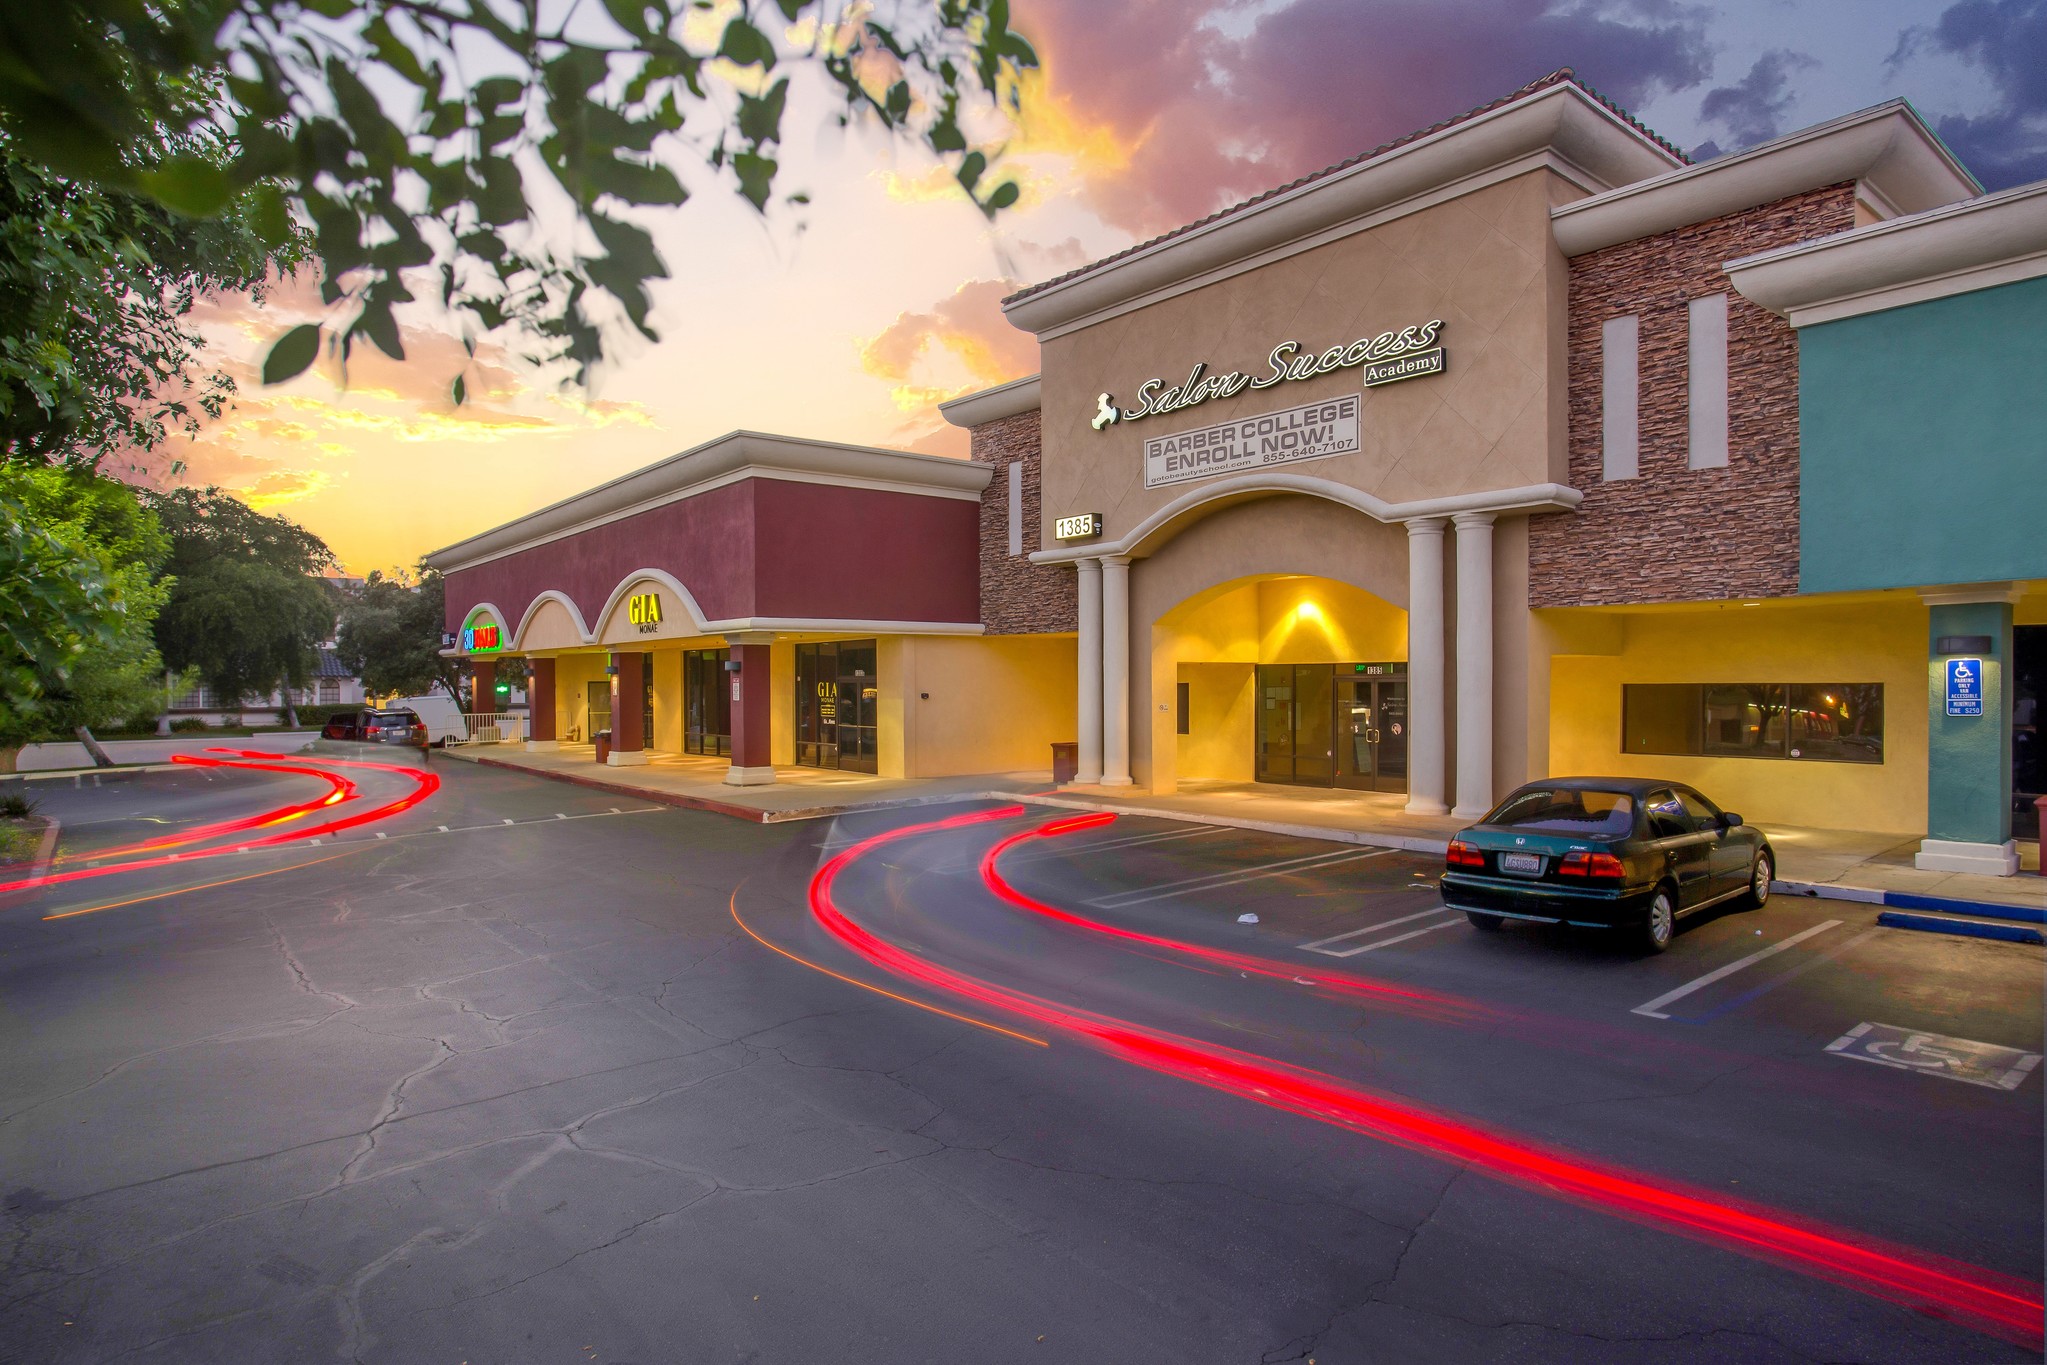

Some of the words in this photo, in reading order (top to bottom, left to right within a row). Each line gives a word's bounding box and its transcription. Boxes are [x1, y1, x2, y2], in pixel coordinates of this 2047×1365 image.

[1123, 363, 1250, 421] Salon
[1250, 319, 1444, 389] Success
[1366, 355, 1440, 381] Academy
[1149, 427, 1236, 459] BARBER
[1241, 401, 1354, 439] COLLEGE
[1166, 442, 1256, 472] ENROLL
[1261, 424, 1334, 453] NOW!
[1263, 439, 1354, 463] 855-640-7107
[1151, 460, 1251, 483] gotobeautyschool.com
[1059, 516, 1090, 537] 1385
[629, 593, 660, 624] GIA
[639, 624, 658, 634] MONAE
[817, 682, 837, 697] GIA
